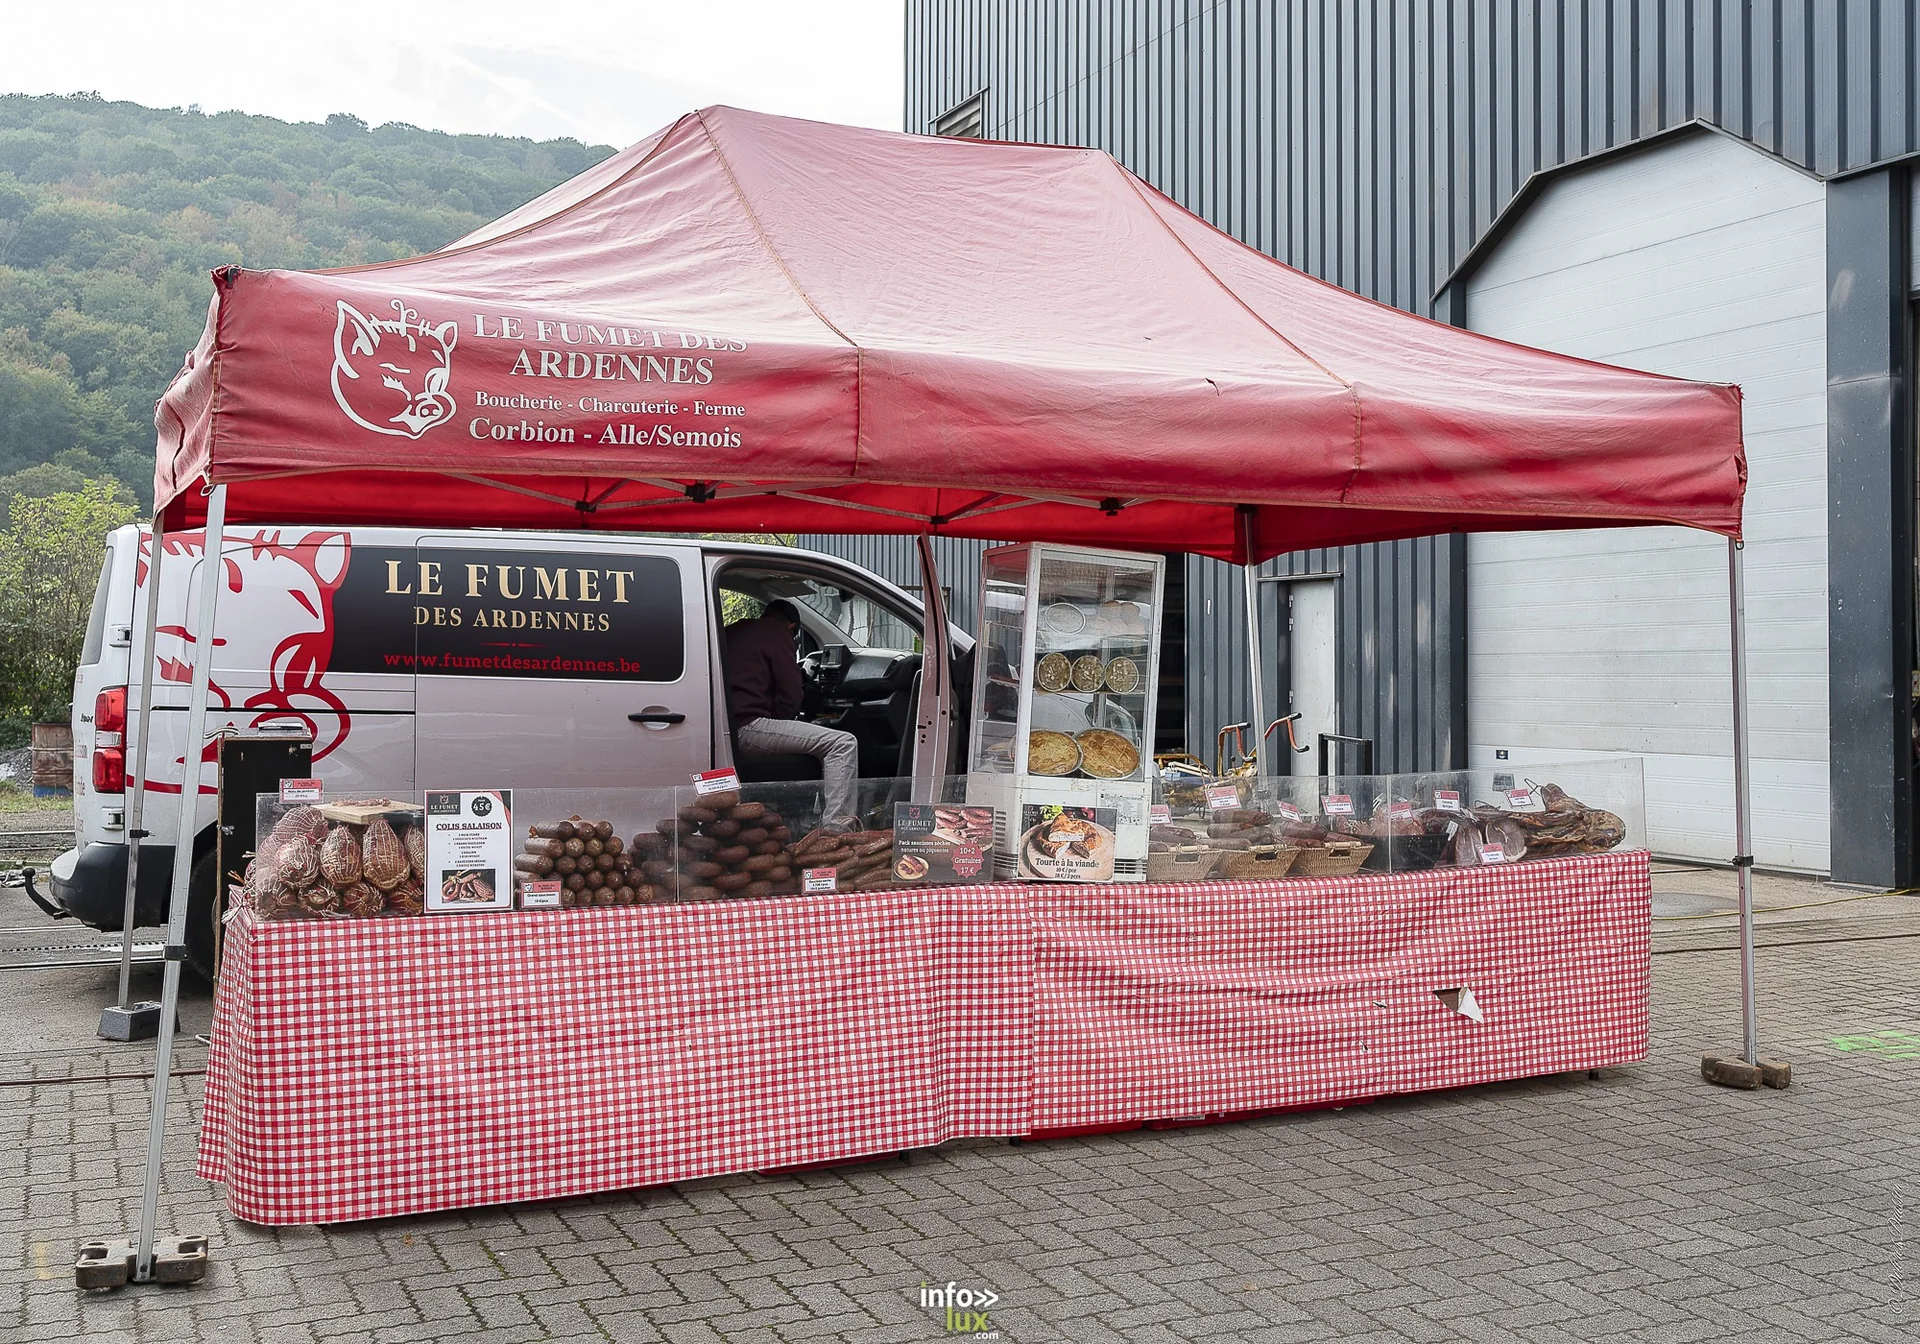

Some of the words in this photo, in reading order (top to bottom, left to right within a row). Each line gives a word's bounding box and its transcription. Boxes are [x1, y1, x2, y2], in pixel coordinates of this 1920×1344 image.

[474, 314, 524, 340] LE
[535, 319, 670, 350] FUMET
[679, 332, 748, 353] DES
[510, 348, 714, 386] ARDENNES
[475, 390, 562, 412] Boucherie
[578, 396, 679, 416] Charcuterie
[693, 400, 746, 418] Ferme
[469, 417, 575, 444] Corbion
[598, 424, 742, 448] Alle/Semois
[385, 560, 443, 596] LE
[464, 564, 634, 603] FUMET
[413, 606, 462, 627] DES
[473, 609, 610, 632] ARDENNES
[384, 652, 640, 672] www.fumetdesardennes.be
[473, 803, 491, 811] 45€
[1035, 858, 1060, 866] Tourte
[1075, 860, 1099, 868] viande
